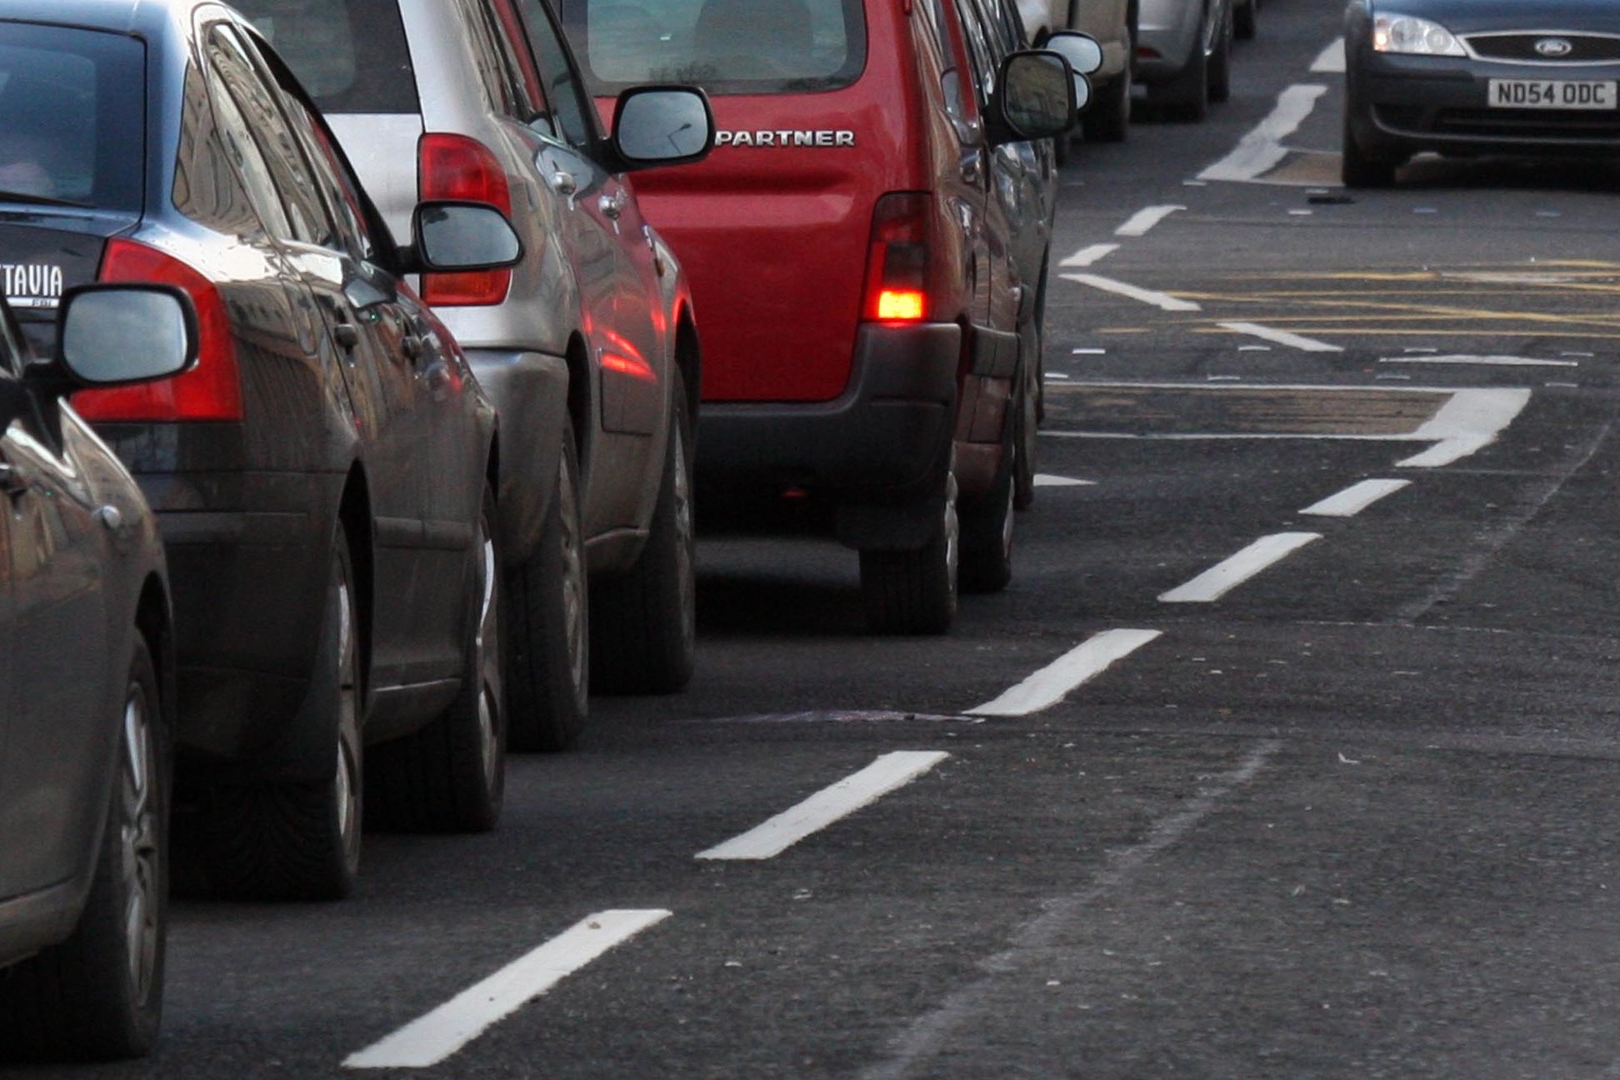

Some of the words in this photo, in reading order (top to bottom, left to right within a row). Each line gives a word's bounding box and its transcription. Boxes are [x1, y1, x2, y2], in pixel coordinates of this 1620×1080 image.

[1498, 83, 1555, 104] ND54
[1563, 84, 1606, 104] ODC
[714, 130, 855, 147] PARTNER
